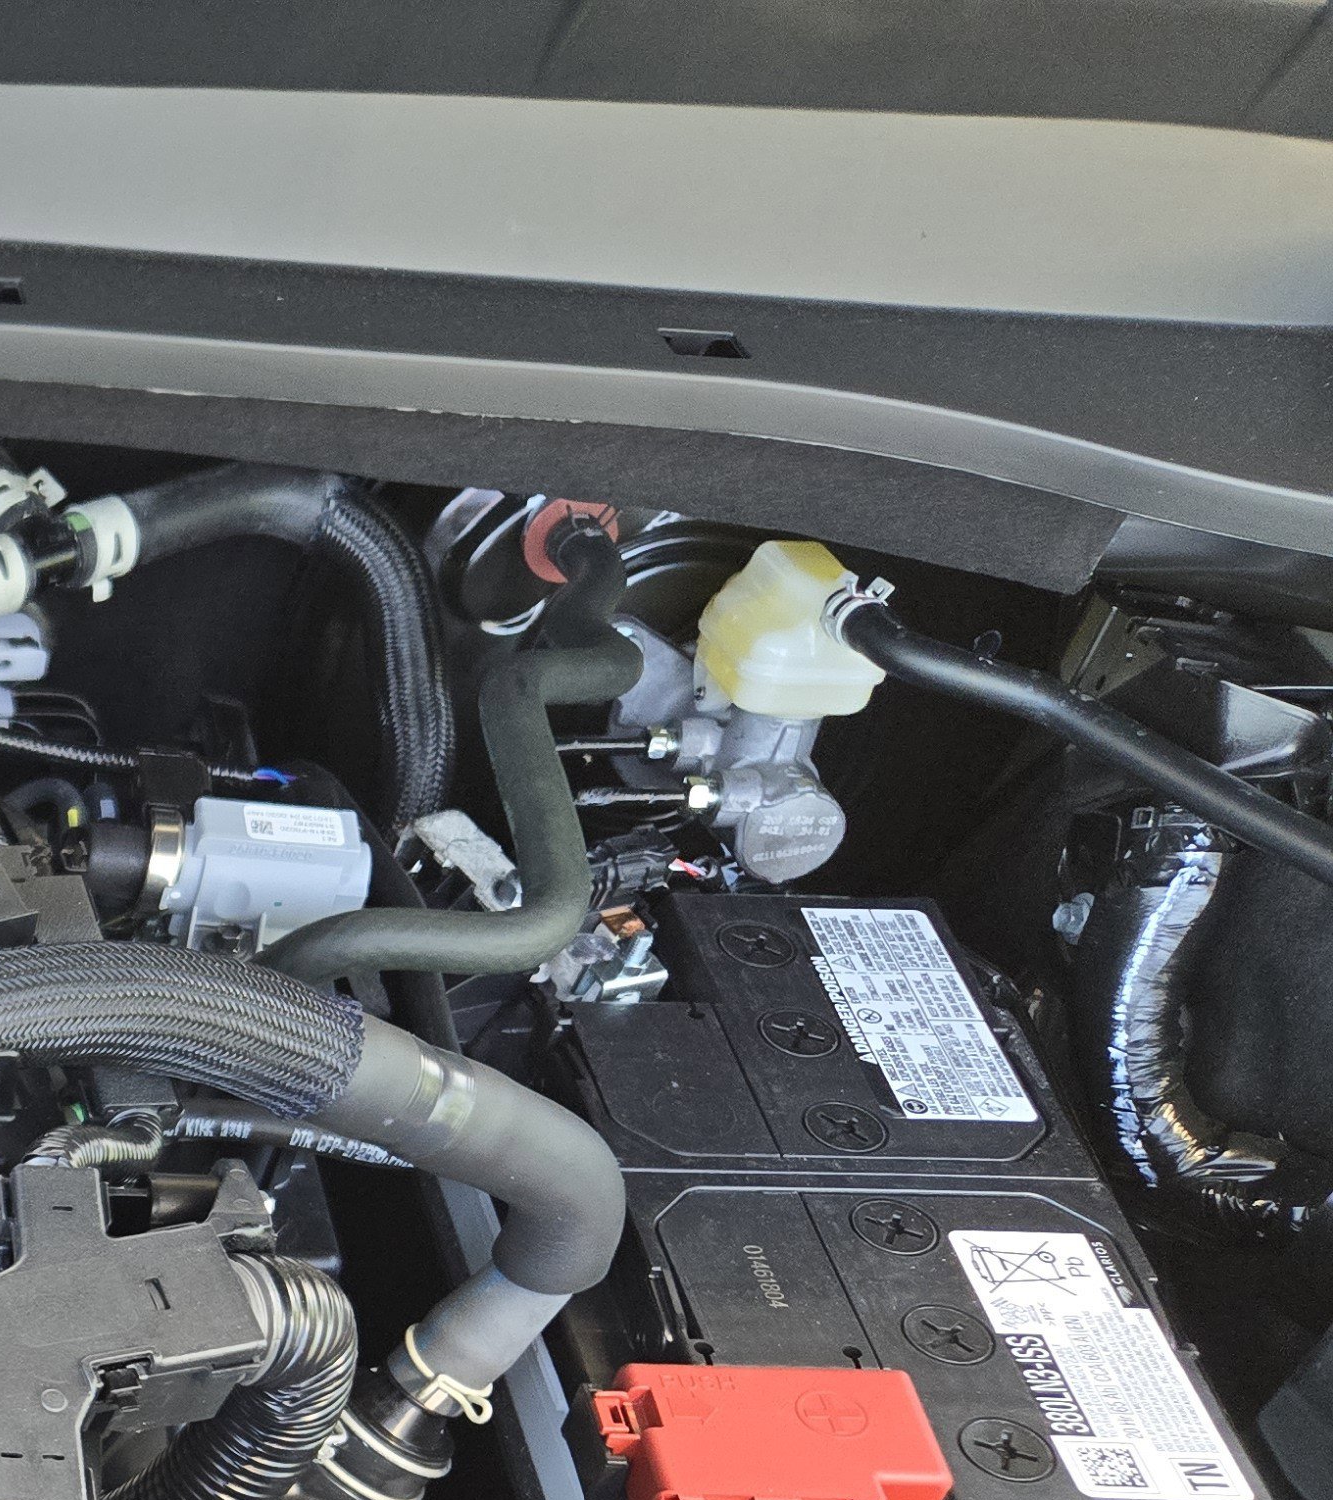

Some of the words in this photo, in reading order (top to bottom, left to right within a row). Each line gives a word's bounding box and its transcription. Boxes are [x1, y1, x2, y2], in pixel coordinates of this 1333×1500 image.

[810, 956, 868, 1052] DANGER/POISON
[743, 1244, 788, 1308] 01461804
[1061, 1256, 1091, 1276] Pb
[1088, 1241, 1125, 1285] CLARIOS
[1003, 1335, 1091, 1432] 380LN3-ISS
[1086, 1364, 1112, 1381] CCA
[1178, 1462, 1231, 1490] TN
